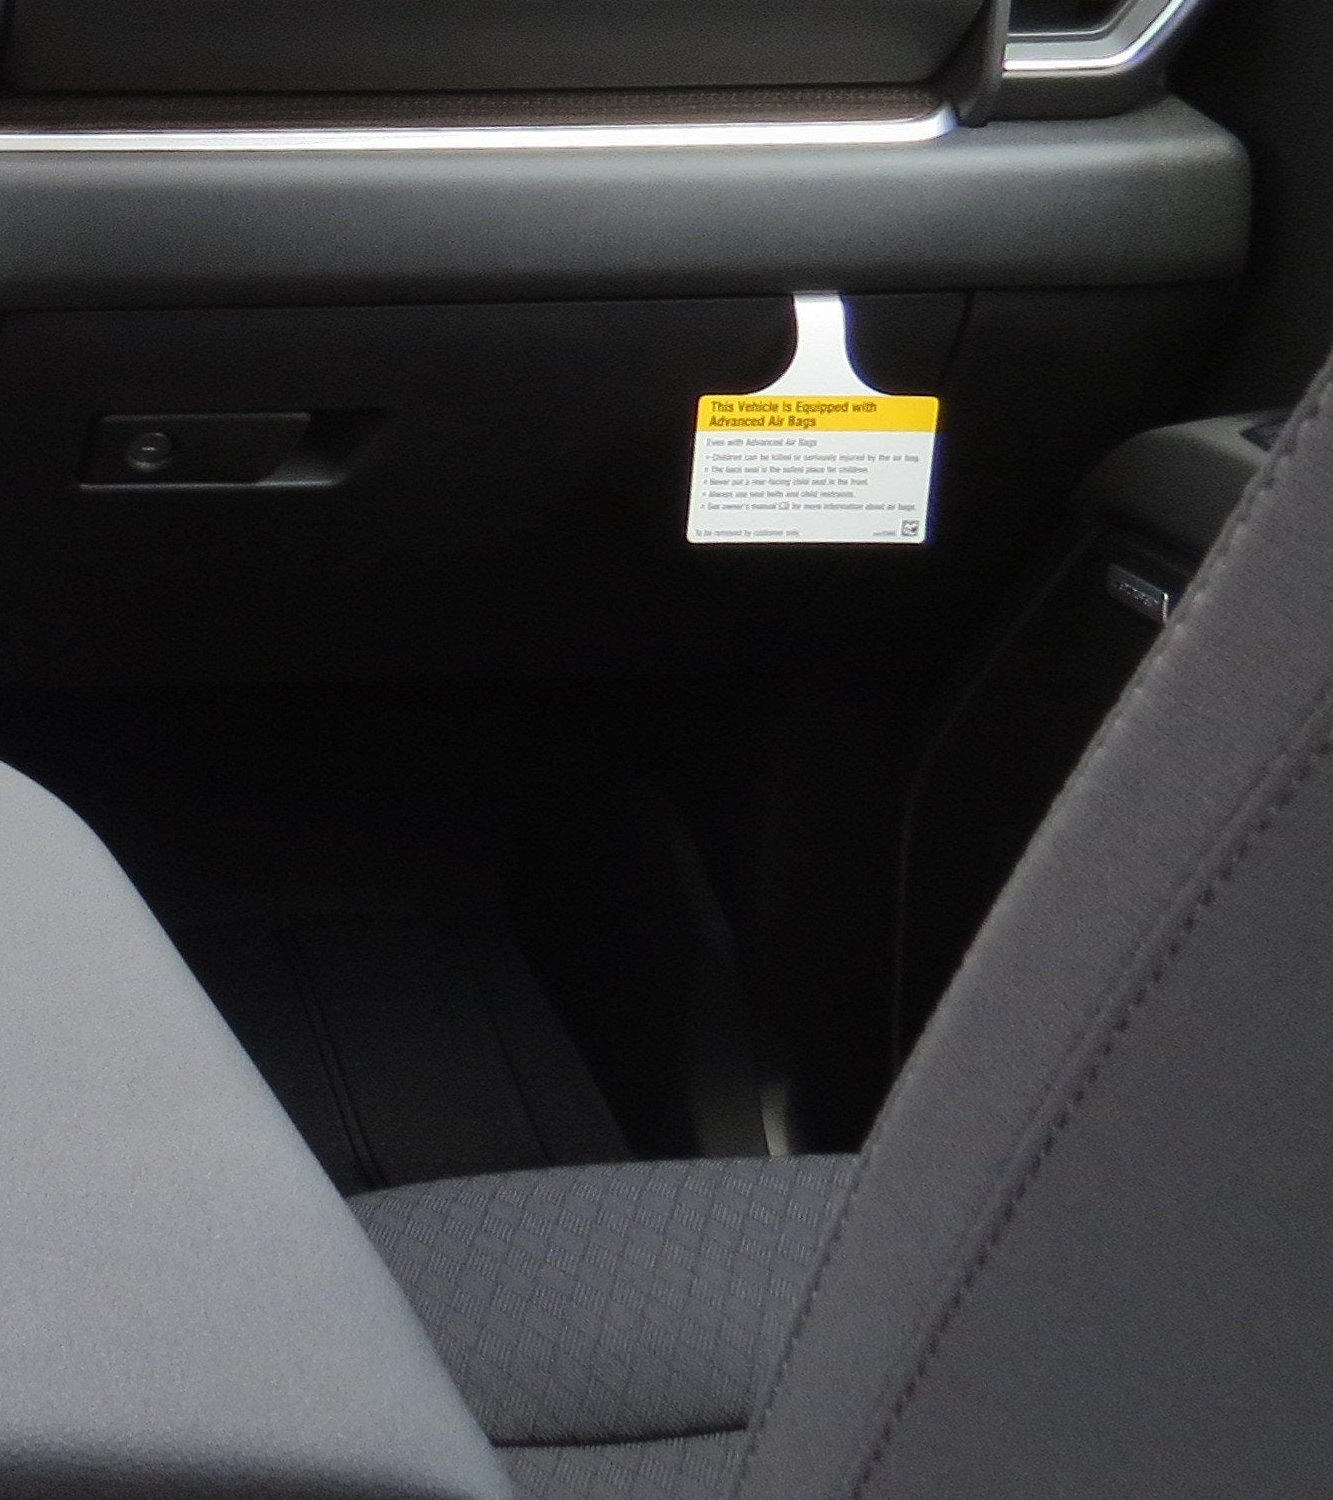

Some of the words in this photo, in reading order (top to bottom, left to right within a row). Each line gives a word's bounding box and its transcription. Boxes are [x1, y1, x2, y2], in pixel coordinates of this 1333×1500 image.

[711, 401, 733, 412] This
[738, 401, 779, 412] Vehicle
[782, 401, 792, 412] is
[795, 401, 848, 414] Equipped
[852, 401, 877, 412] with
[709, 415, 764, 427] Advanced
[768, 415, 784, 427] Air
[788, 416, 817, 429] Bags
